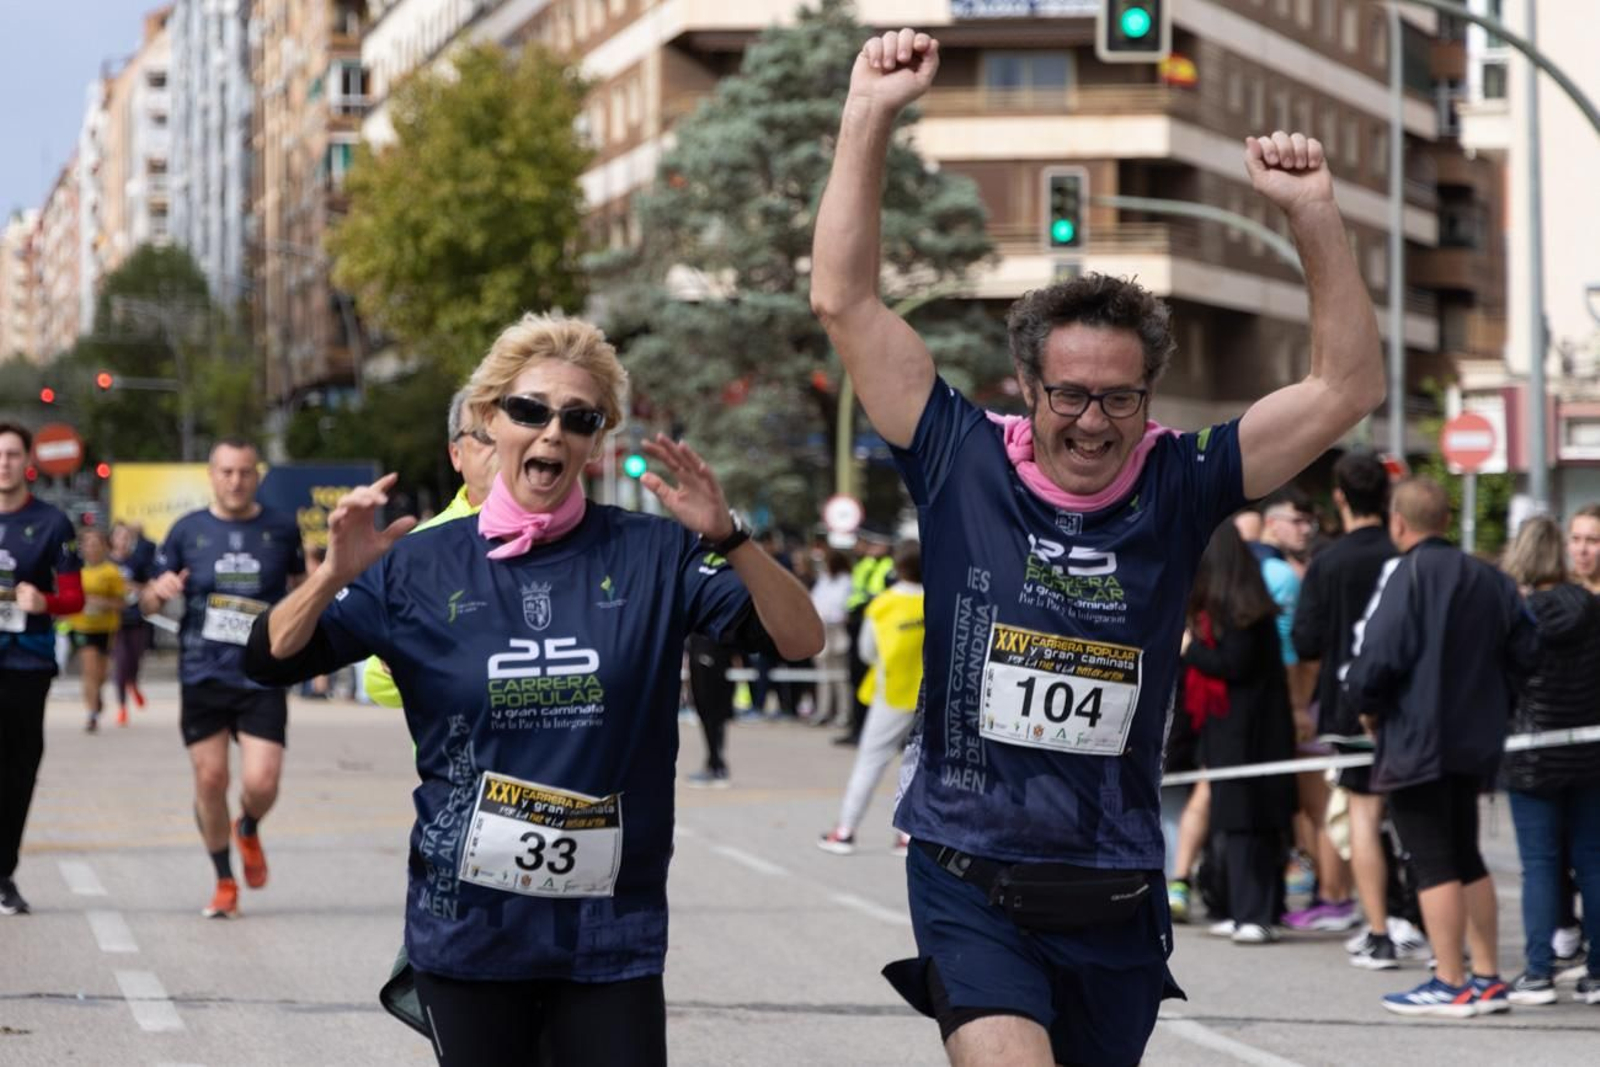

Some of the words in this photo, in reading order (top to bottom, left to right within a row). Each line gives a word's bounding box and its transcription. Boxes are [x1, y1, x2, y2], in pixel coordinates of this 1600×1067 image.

[1028, 532, 1117, 576] 25
[967, 566, 992, 593] IES
[1024, 582, 1034, 593] y
[1036, 585, 1064, 602] gran
[487, 637, 600, 680] 25
[952, 596, 973, 692] CATALINA
[995, 629, 1031, 655] XXV
[1030, 636, 1083, 654] CARRERA
[1085, 645, 1136, 661] POPULAR
[1029, 646, 1038, 657] y
[1043, 648, 1074, 661] gran
[1080, 653, 1135, 671] caminata
[488, 674, 601, 693] CARRERA
[491, 688, 604, 709] POPULAR
[491, 709, 502, 719] y
[505, 708, 537, 719] gran
[540, 703, 605, 716] caminata
[1016, 676, 1103, 729] 104
[949, 698, 963, 759] SANTA
[966, 735, 981, 764] DE
[486, 779, 522, 806] XXV
[521, 788, 574, 808] CARRERA
[521, 798, 529, 808] y
[534, 801, 565, 814] gran
[515, 831, 578, 875] 33
